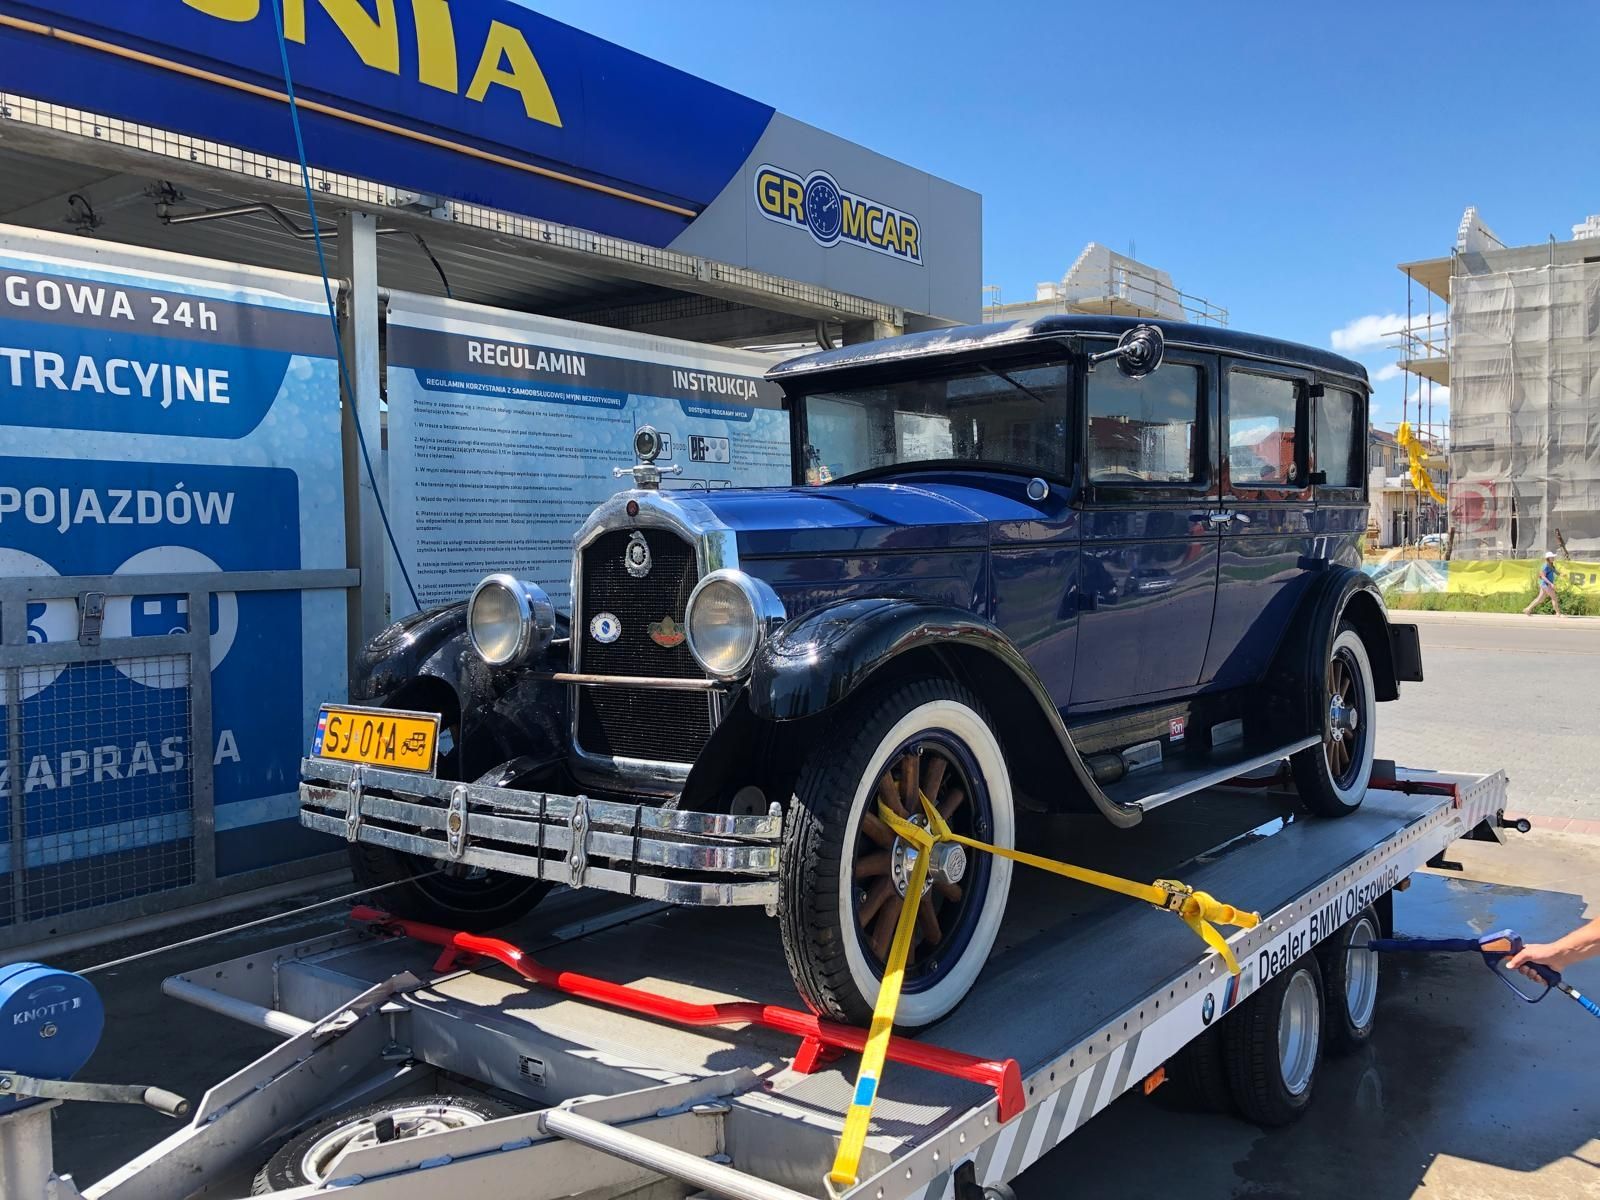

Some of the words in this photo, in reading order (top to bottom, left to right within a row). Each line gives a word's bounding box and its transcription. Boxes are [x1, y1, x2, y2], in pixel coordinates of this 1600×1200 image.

[183, 0, 562, 127] NIA
[5, 276, 135, 320] GOWA
[150, 296, 217, 331] 24h
[0, 347, 230, 409] TRACYJNE
[468, 341, 586, 376] REGULAMIN
[426, 378, 465, 389] REGULAMIN
[465, 383, 506, 394] KORZYSTANIA
[511, 387, 565, 399] SAMOOBSŁUGOWEJ
[672, 370, 759, 401] INSTRUKCJA
[0, 481, 235, 534] POJAZDÓW
[326, 716, 354, 754] SJ
[360, 719, 397, 761] 01A
[1259, 927, 1305, 986] Dealer
[1310, 896, 1343, 949] BMW
[1345, 863, 1399, 920] Olszowiec
[13, 999, 69, 1025] KNOTT
